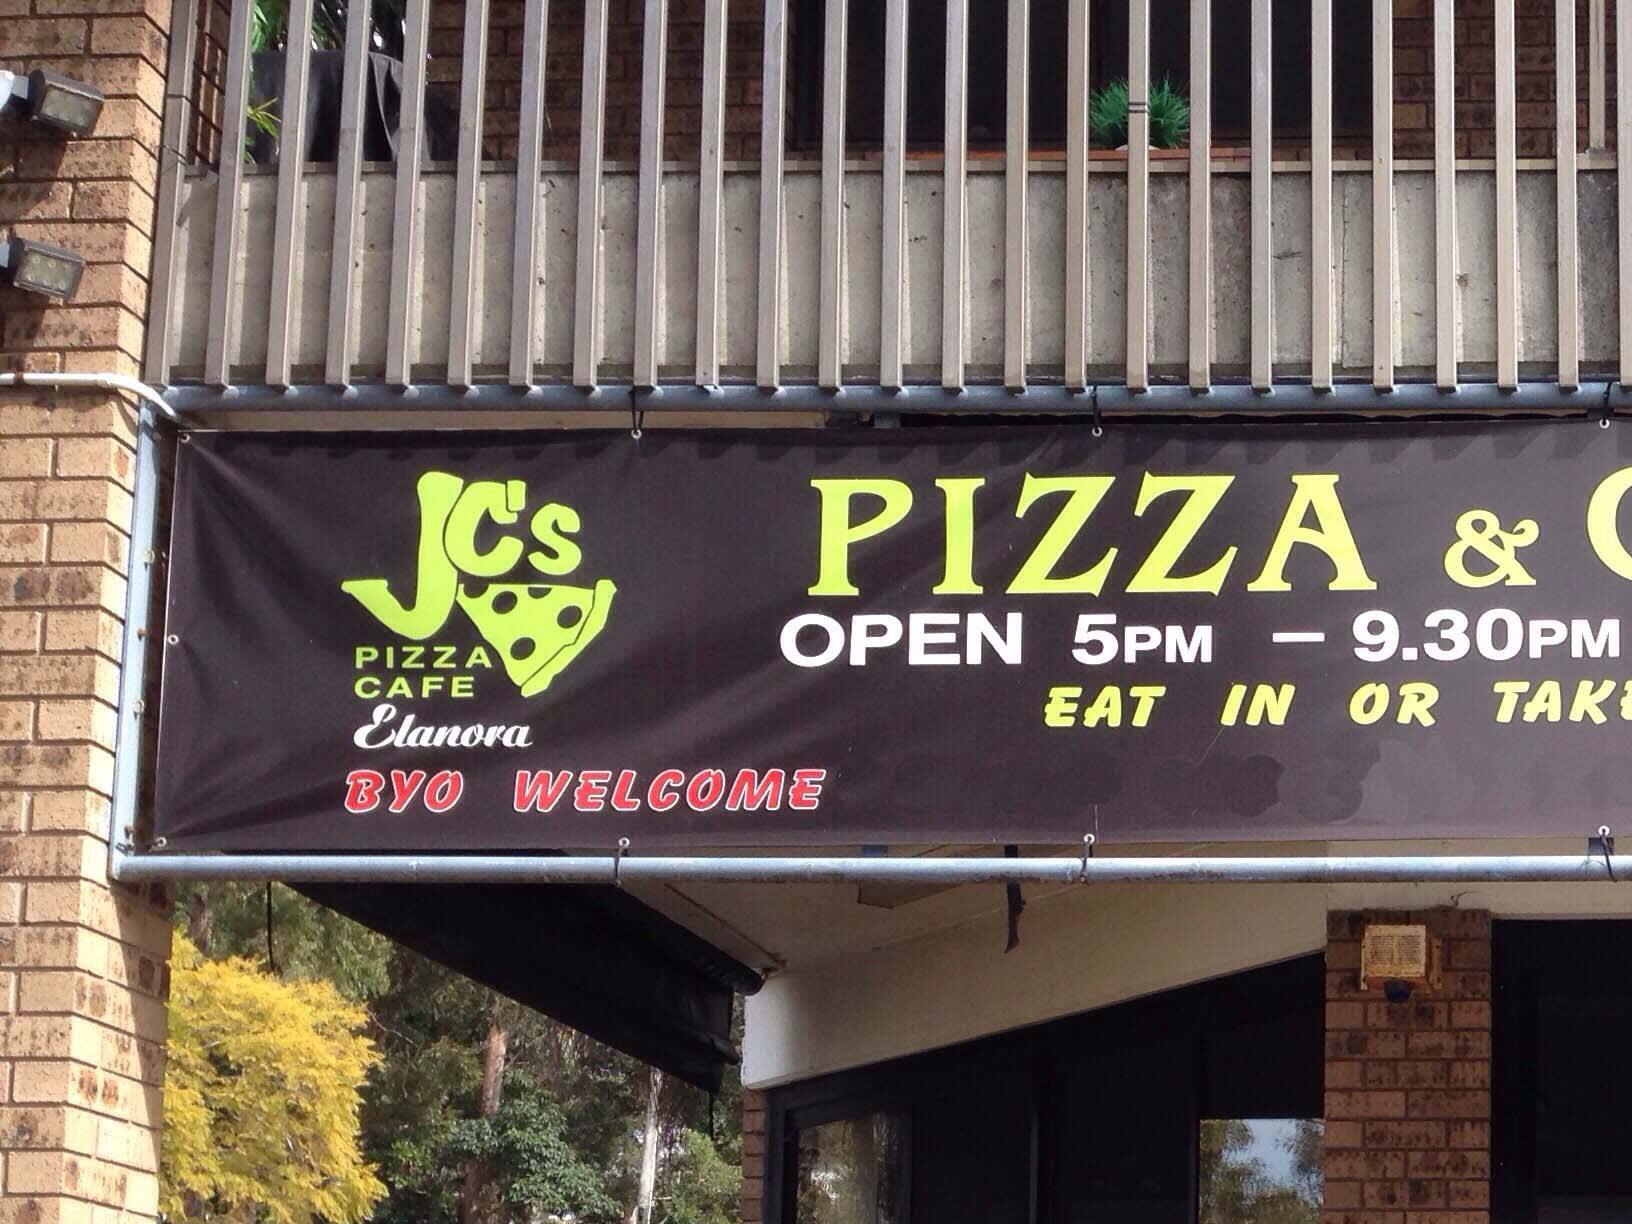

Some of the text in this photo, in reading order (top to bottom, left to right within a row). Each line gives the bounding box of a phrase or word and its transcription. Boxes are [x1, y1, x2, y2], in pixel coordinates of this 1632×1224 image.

[808, 471, 1377, 596] PIZZA
[1445, 510, 1539, 587] &
[356, 647, 491, 668] PIZZA
[780, 613, 1022, 667] OPEN
[1072, 614, 1212, 664] 5PM
[1353, 609, 1619, 662] 9.30PM
[355, 677, 474, 698] CAFE
[1045, 686, 1166, 727] EAT
[1221, 684, 1295, 726] IN
[1350, 683, 1439, 727] OR
[354, 704, 532, 748] Elanora
[345, 768, 826, 813] BYO WELCOME
